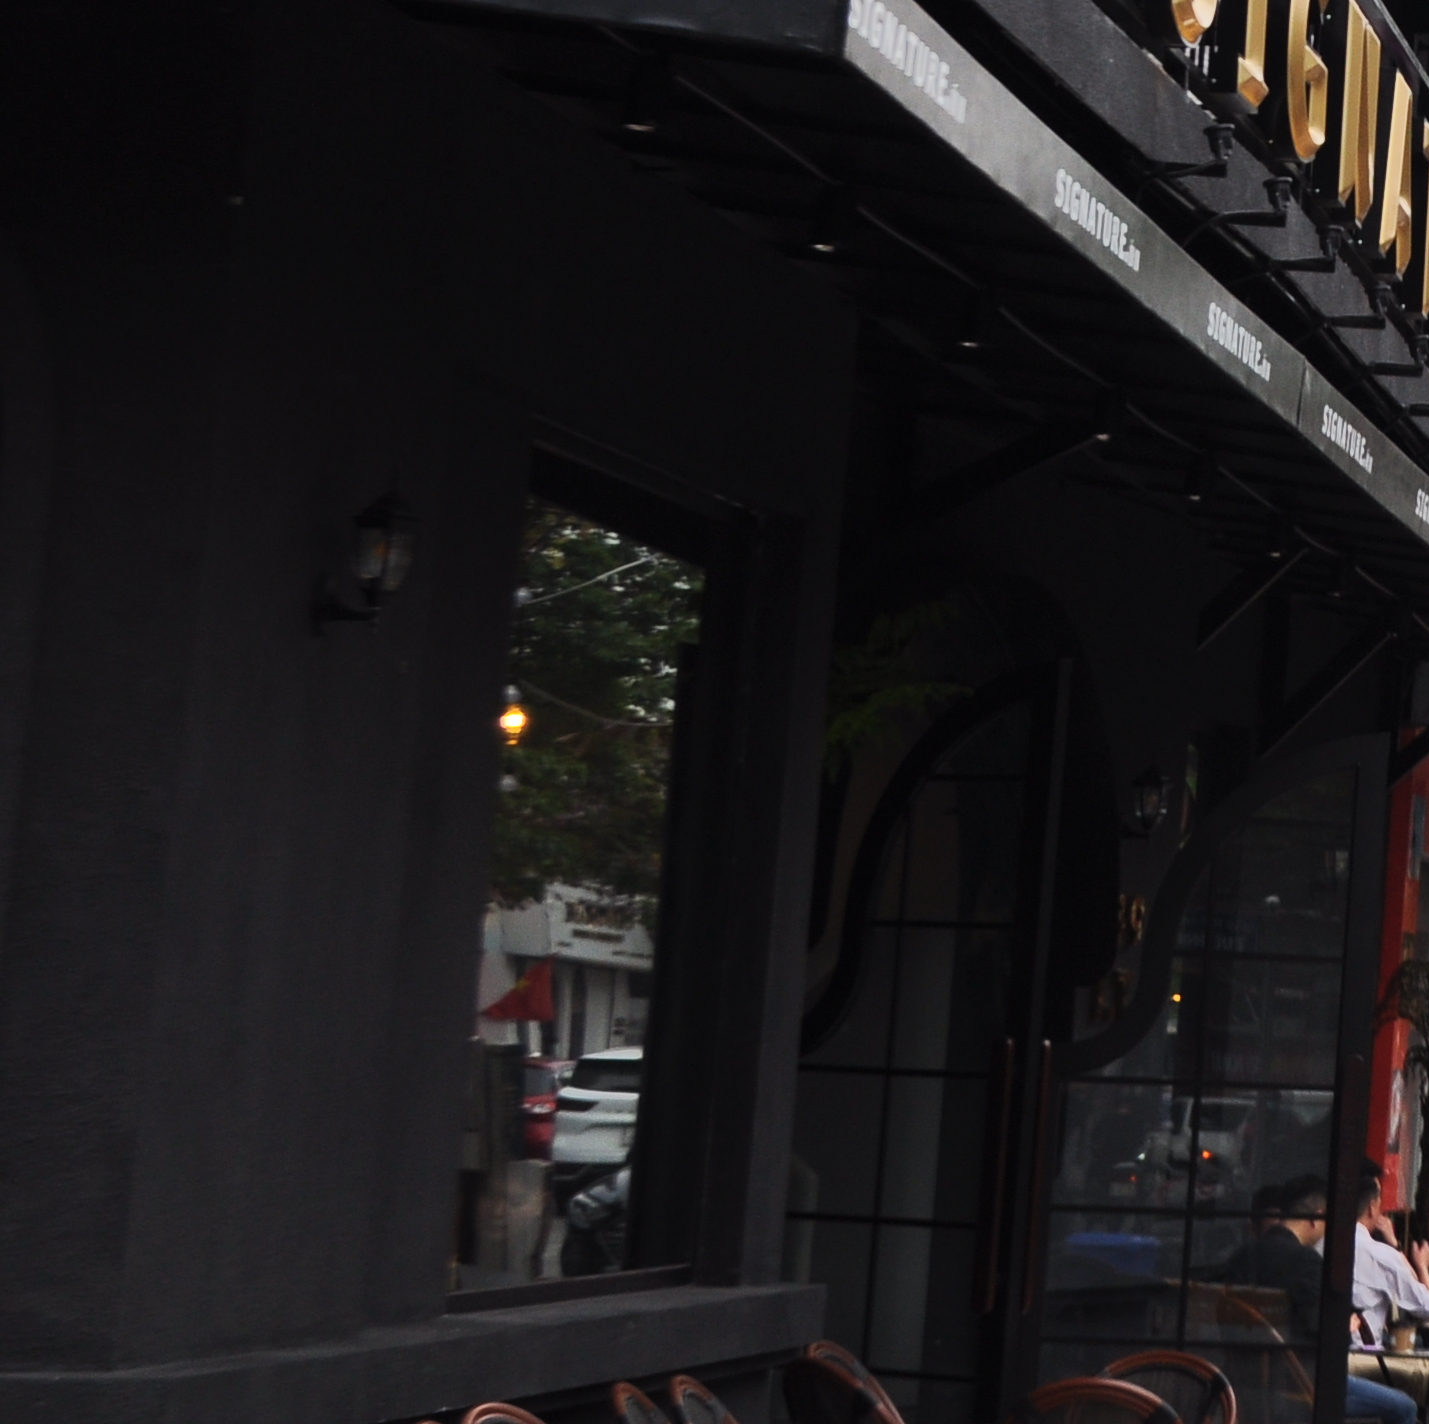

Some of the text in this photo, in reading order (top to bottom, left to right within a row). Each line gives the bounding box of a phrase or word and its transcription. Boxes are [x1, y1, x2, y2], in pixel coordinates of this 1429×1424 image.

[1054, 168, 1129, 262] SIGNATURE
[1207, 302, 1263, 374] SIGNATURE
[1322, 404, 1367, 465] SIGNATURE
